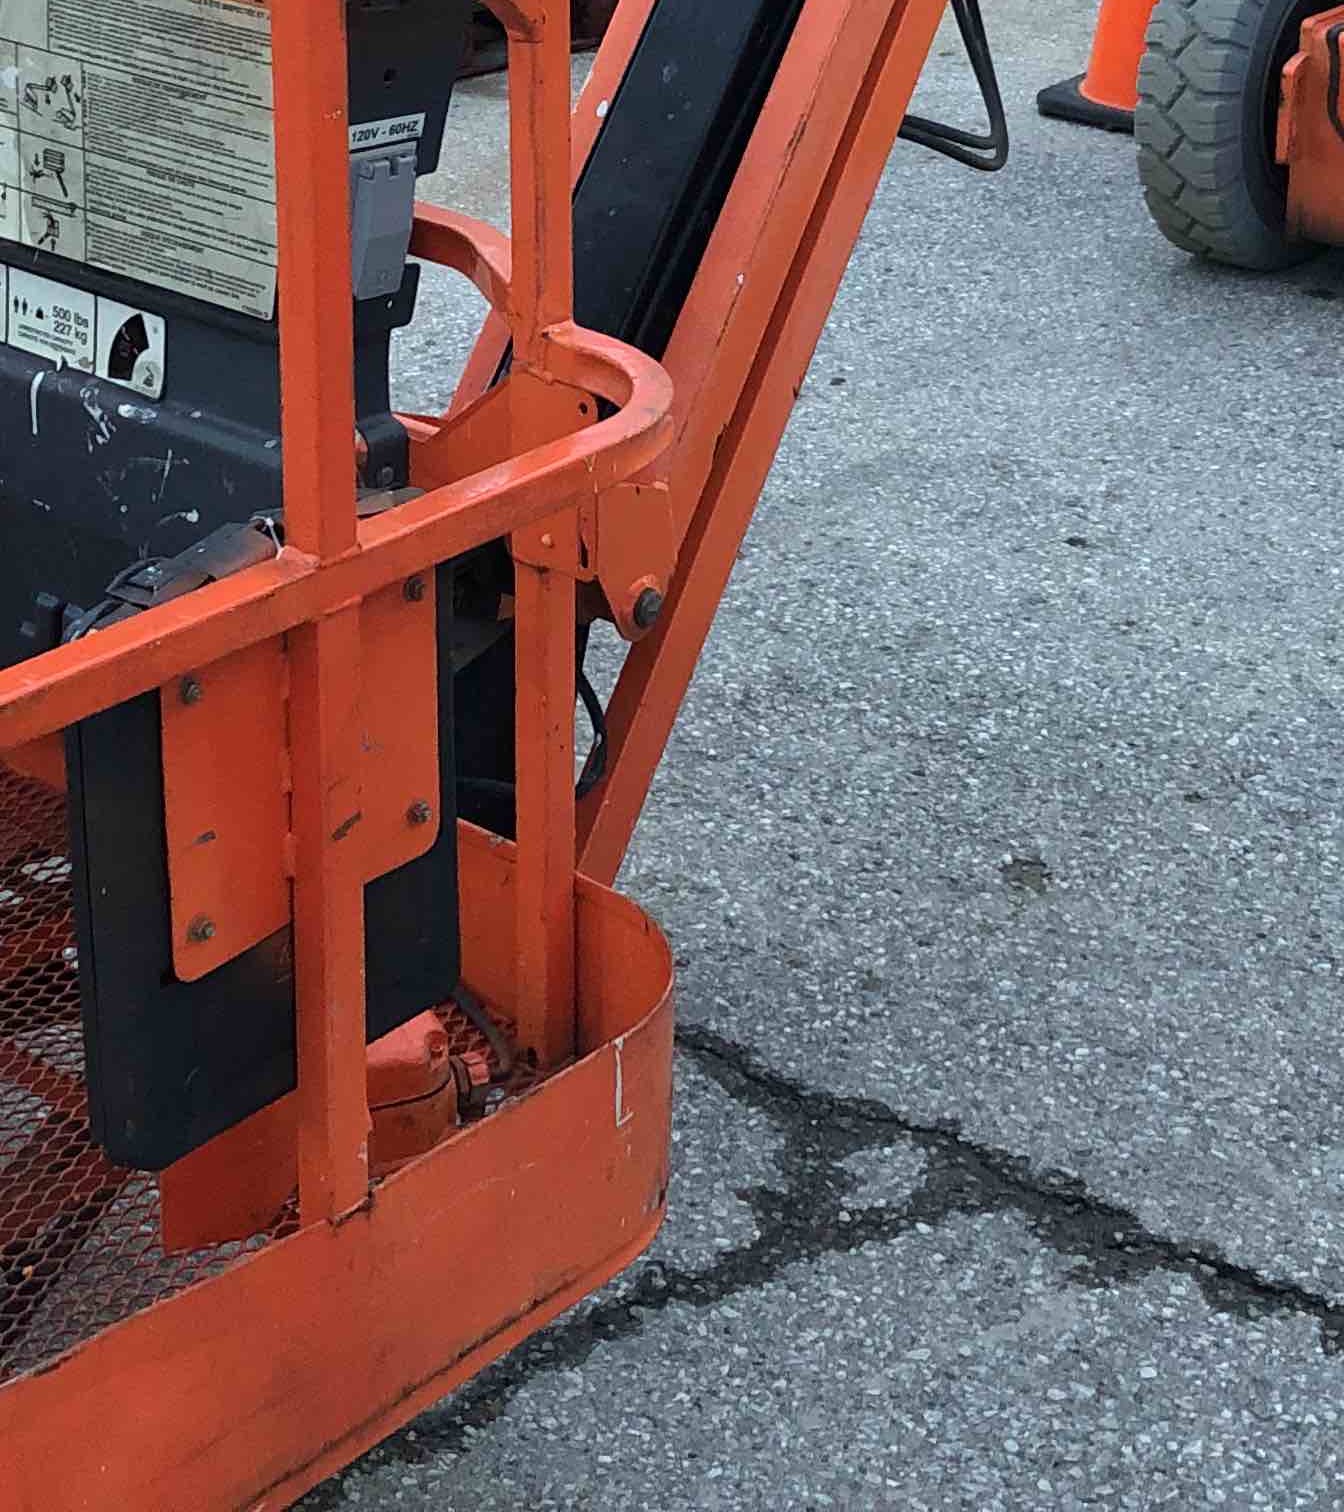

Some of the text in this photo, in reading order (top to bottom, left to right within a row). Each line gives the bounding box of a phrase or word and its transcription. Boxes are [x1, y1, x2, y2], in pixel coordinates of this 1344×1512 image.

[351, 128, 379, 143] 120V
[51, 306, 89, 328] 500 lbs
[53, 320, 72, 338] 227
[75, 326, 88, 346] kg
